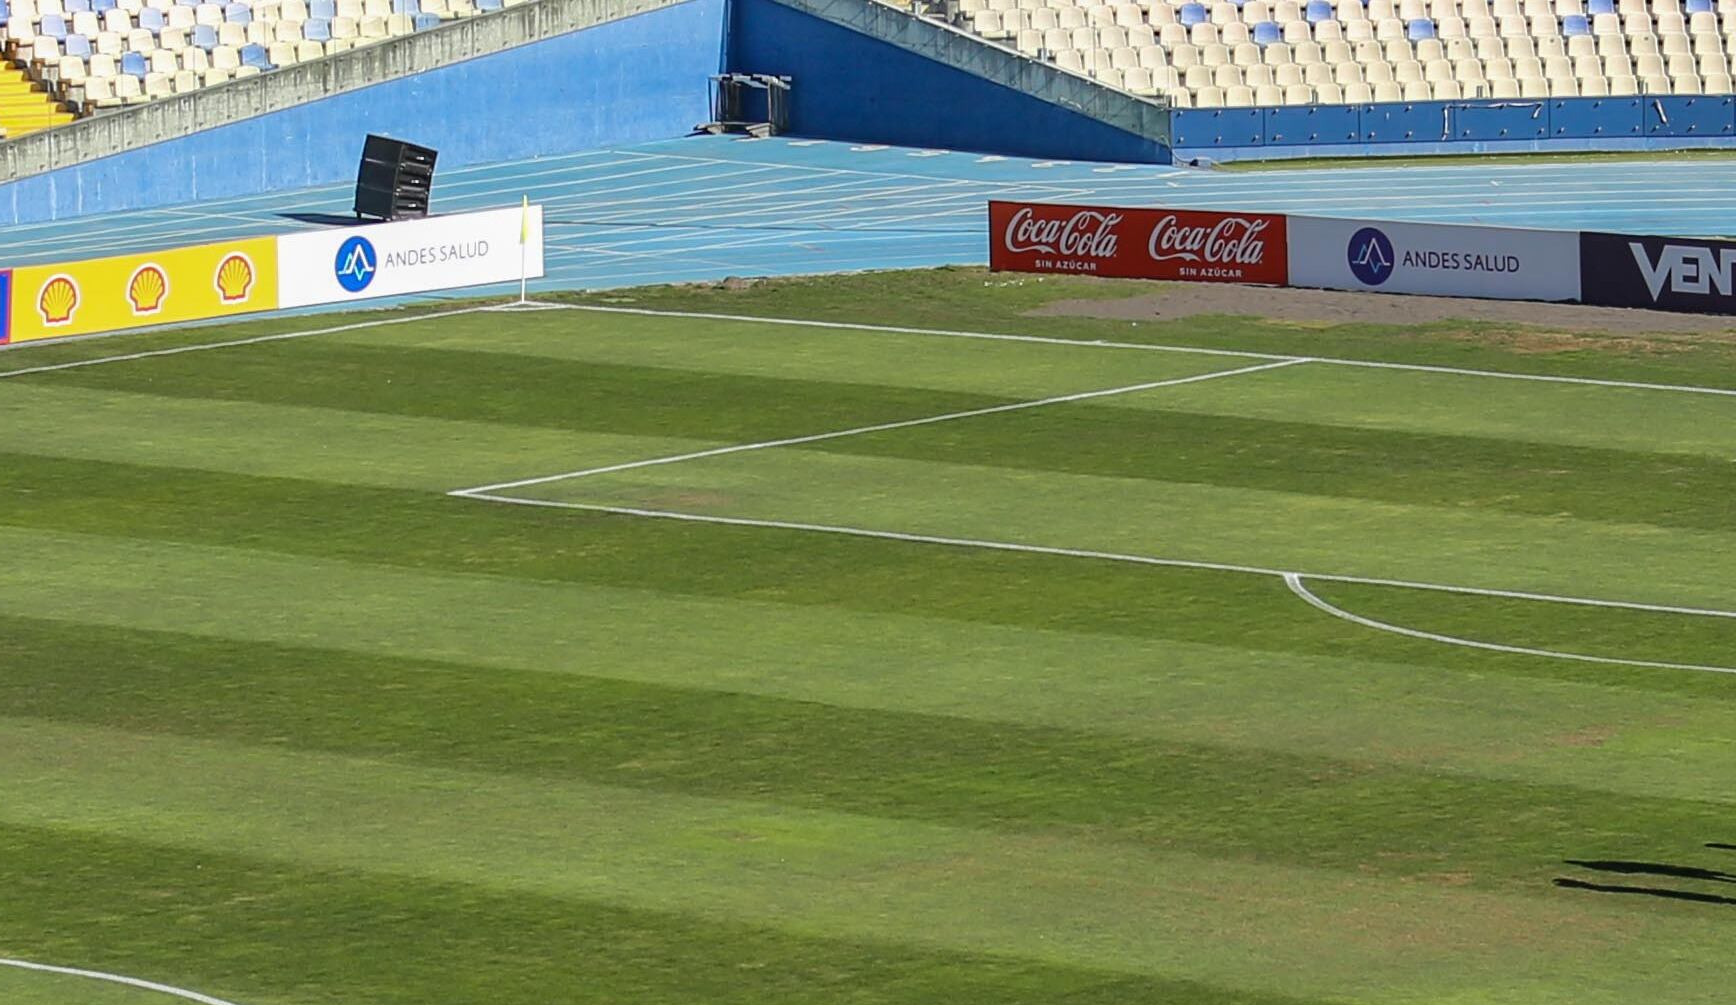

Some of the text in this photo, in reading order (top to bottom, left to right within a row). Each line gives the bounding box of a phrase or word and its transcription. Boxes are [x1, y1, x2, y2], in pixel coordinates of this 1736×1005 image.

[385, 240, 489, 269] ANDES SALUD
[1035, 259, 1097, 271] SIN AZÚCAR
[1402, 250, 1520, 273] ANDES SALUD
[1179, 266, 1242, 278] SIN AZÚCAR
[1628, 242, 1736, 302] VEN
